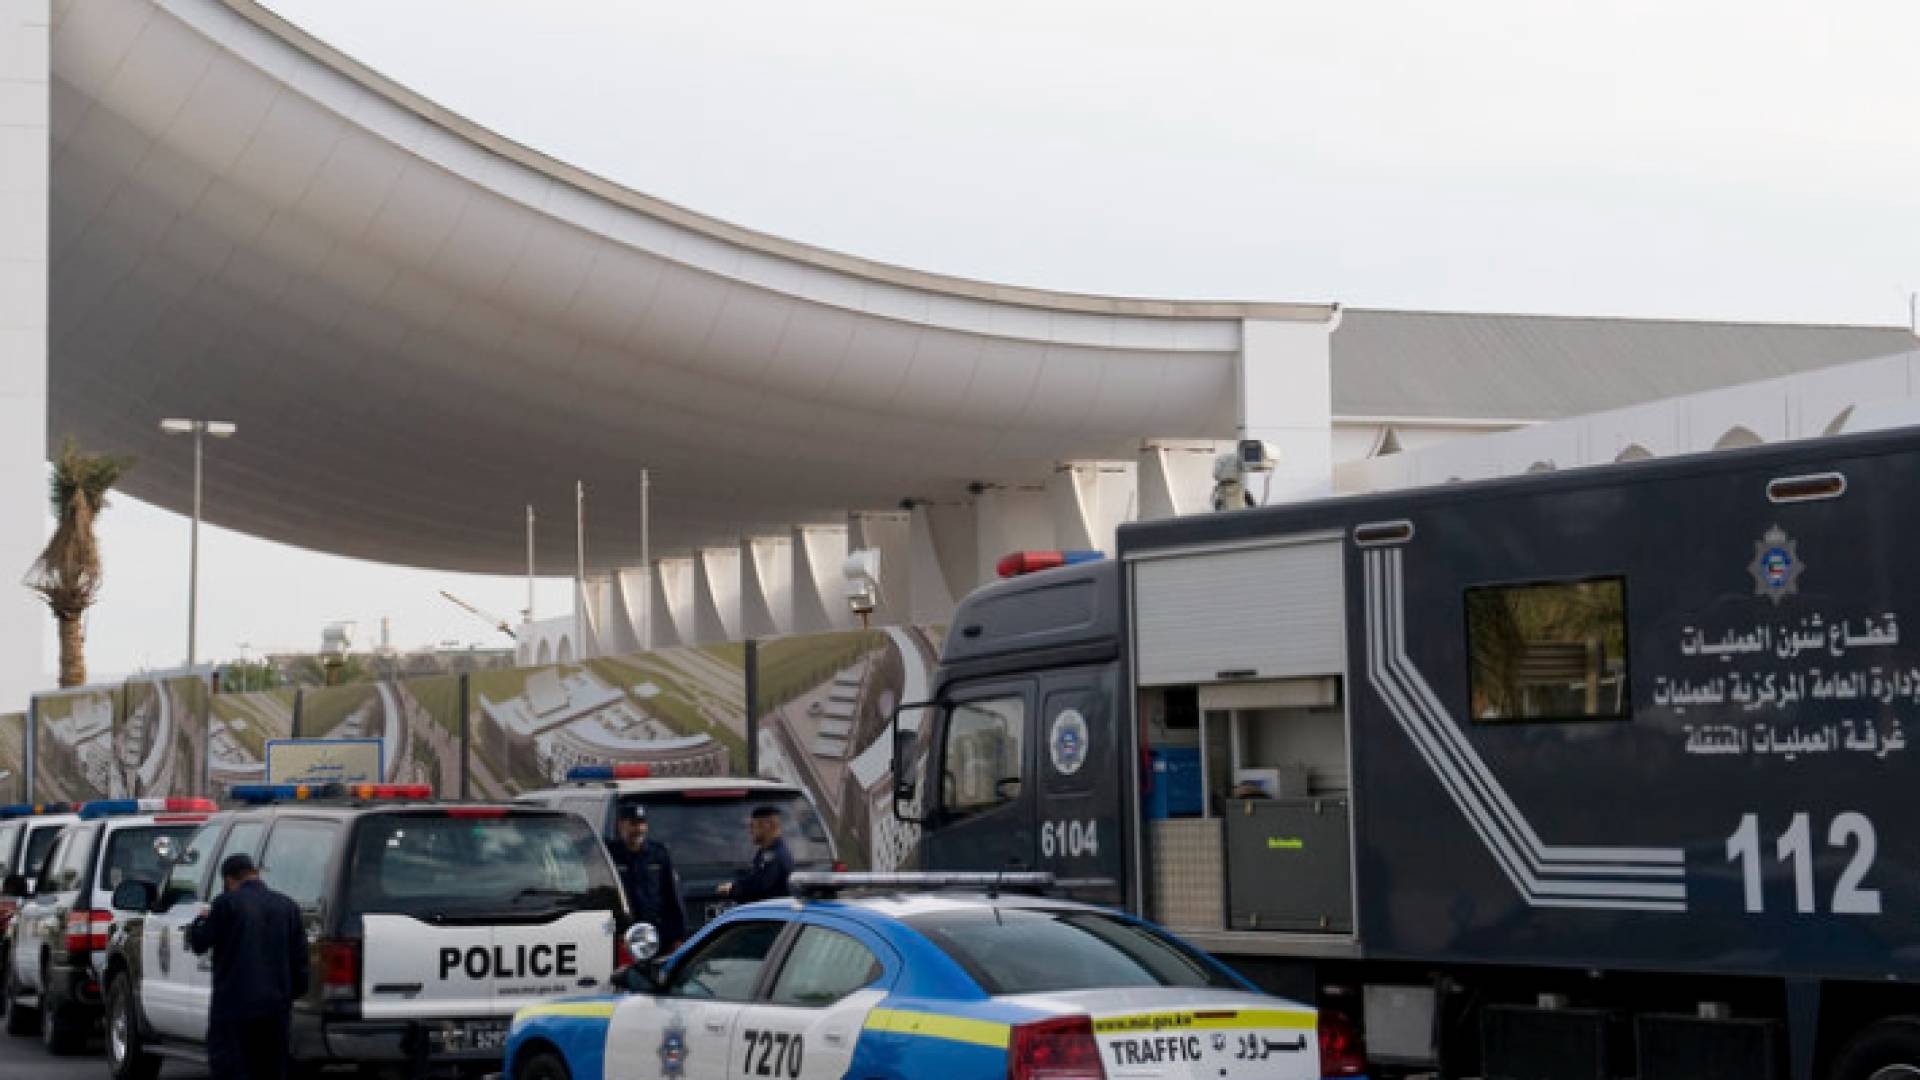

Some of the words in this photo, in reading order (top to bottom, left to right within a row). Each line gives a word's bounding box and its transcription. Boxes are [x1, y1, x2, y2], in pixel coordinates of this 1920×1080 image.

[1681, 623, 1773, 662] العمليات
[1829, 612, 1899, 657] قطاع
[1653, 676, 1725, 714] للعمليات
[1728, 671, 1805, 709] المركزية
[1809, 667, 1867, 698] العامة
[1681, 723, 1749, 755] المتنقلة
[1752, 722, 1840, 761] العمليات
[1841, 719, 1906, 759] غرفة
[1041, 818, 1099, 857] 6104
[1725, 811, 1882, 914] 112
[438, 943, 578, 981] POLICE
[744, 1030, 803, 1079] 7270
[1109, 1035, 1203, 1065] TRAFFIC
[1233, 1032, 1308, 1061] مرور
